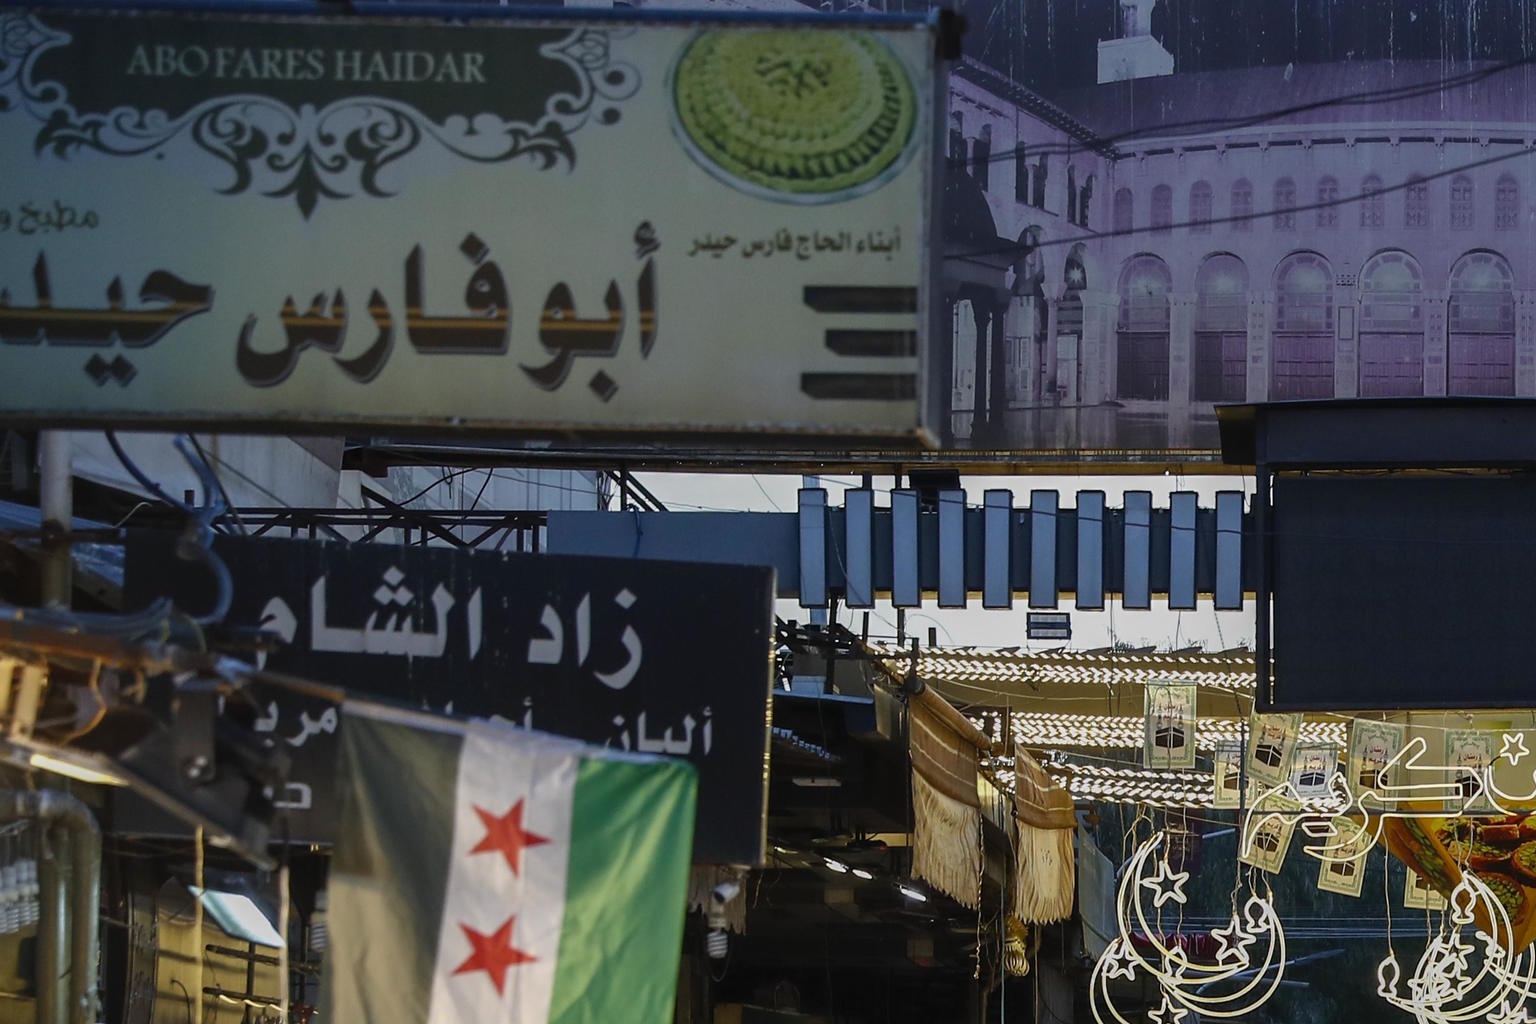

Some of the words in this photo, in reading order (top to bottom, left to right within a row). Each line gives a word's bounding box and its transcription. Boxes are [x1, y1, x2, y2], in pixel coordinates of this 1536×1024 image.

[127, 46, 209, 79] ABO
[215, 47, 325, 83] FARES
[334, 49, 487, 86] HAIDAR
[19, 200, 99, 234] مطبخ
[688, 233, 737, 257] حيدر
[742, 228, 793, 257] فارس
[796, 231, 852, 260] الحاج
[857, 227, 901, 261] أبناء
[236, 233, 512, 390] فارس
[519, 221, 661, 402] أبو
[257, 567, 483, 673] الشام
[528, 587, 643, 690] زاد
[1241, 736, 1483, 861] كريم
